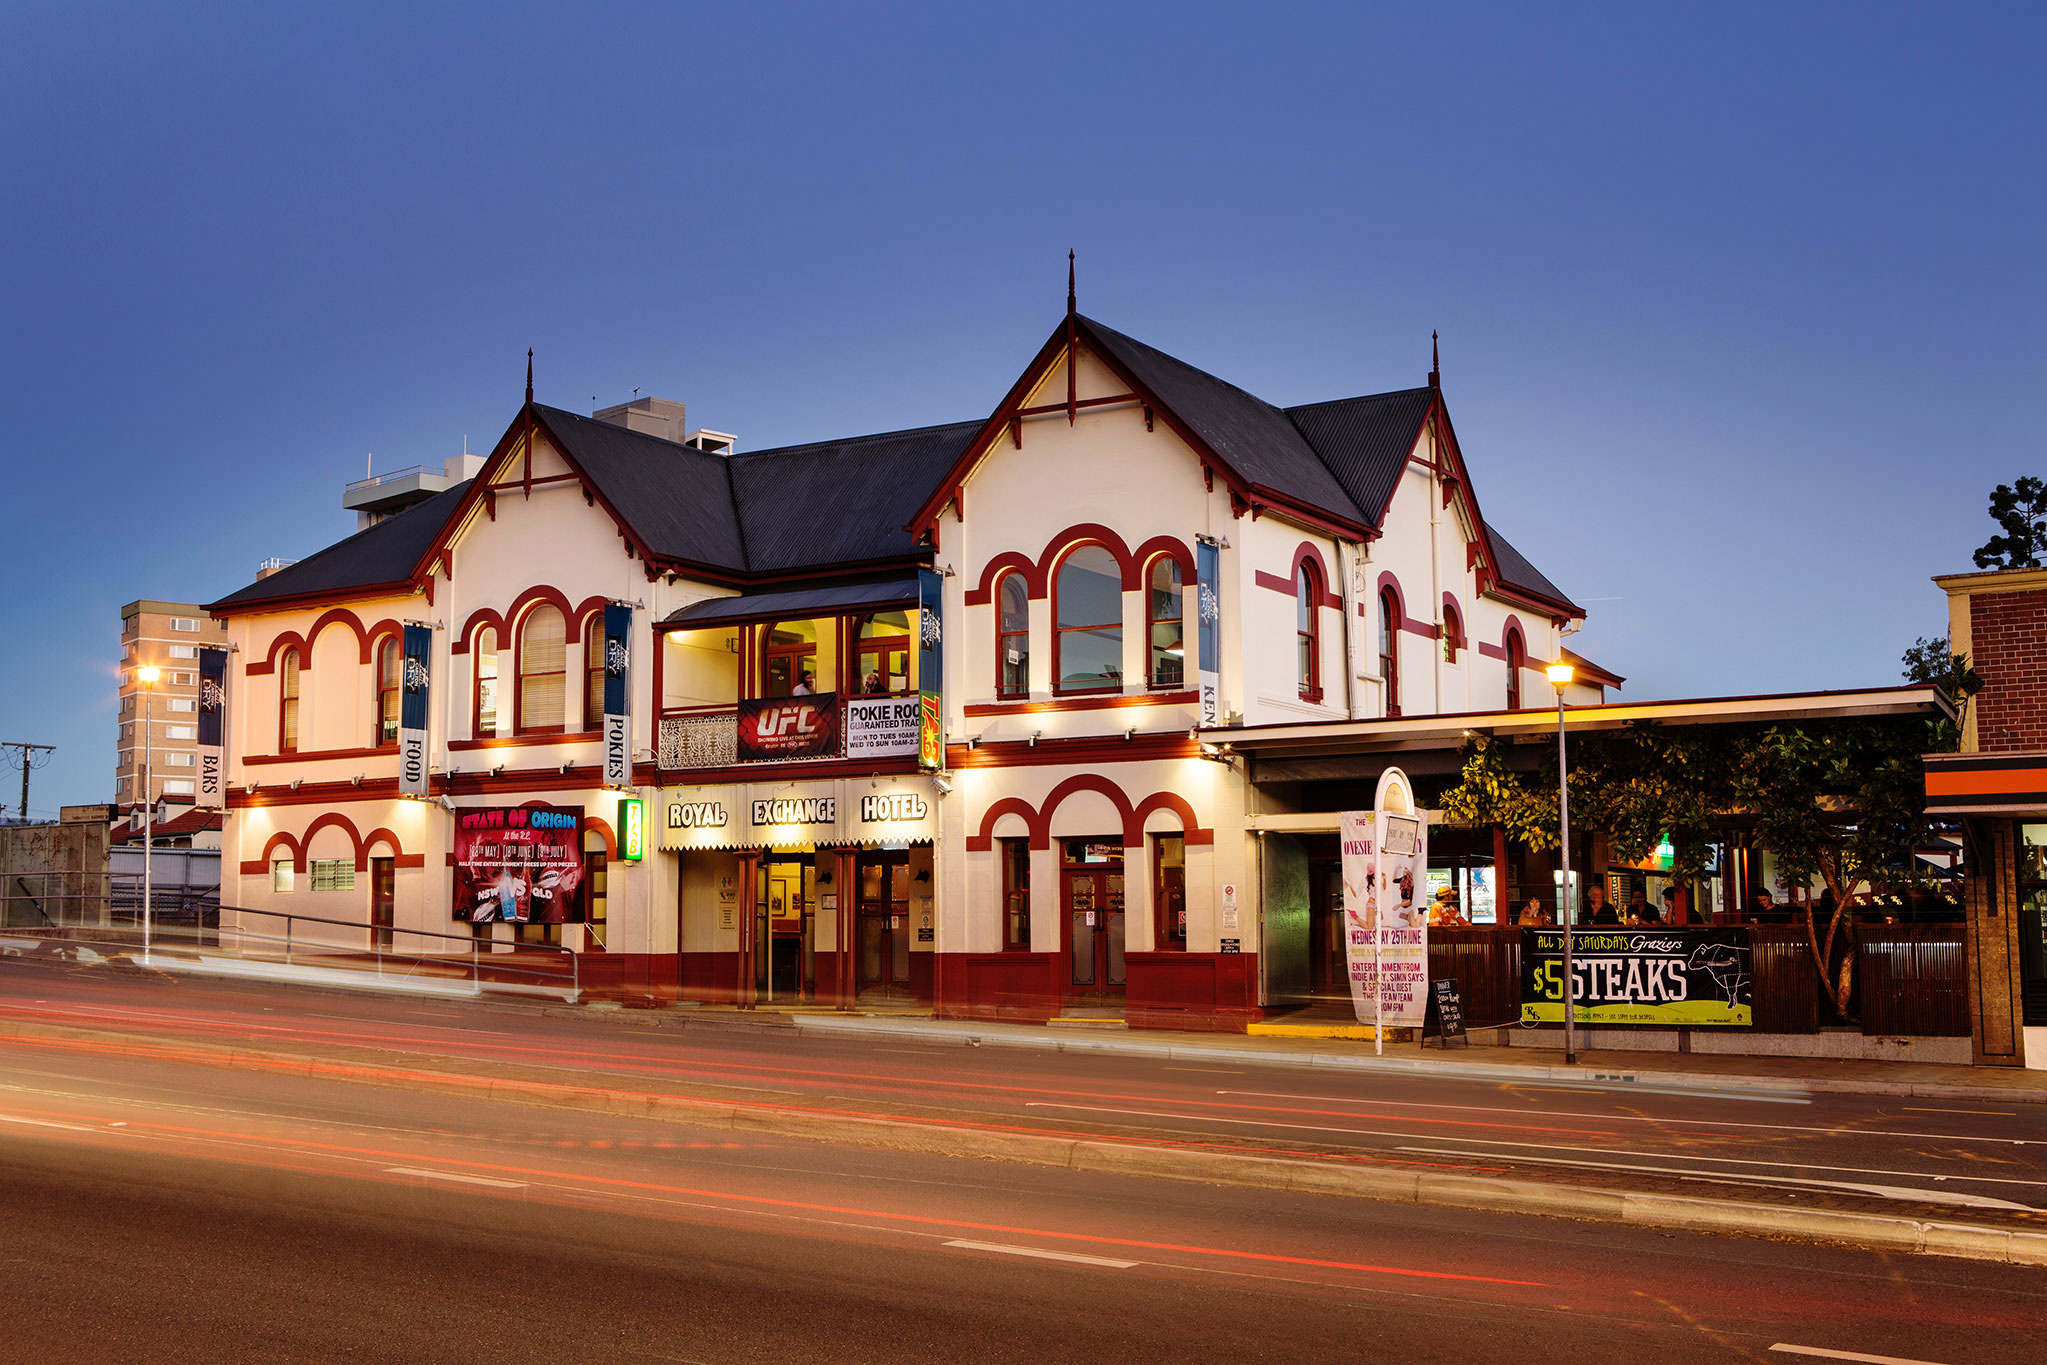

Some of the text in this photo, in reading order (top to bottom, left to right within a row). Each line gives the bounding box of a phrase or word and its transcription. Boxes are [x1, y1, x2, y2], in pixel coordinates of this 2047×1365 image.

[921, 608, 929, 647] DRY
[608, 639, 617, 675] DRY
[407, 657, 416, 691] DRY
[202, 679, 211, 711] DRY
[1203, 684, 1216, 728] KEN
[756, 705, 816, 736] UFC
[850, 705, 891, 721] POKIE
[850, 720, 900, 730] GUARANTEED
[922, 696, 940, 764] TAB
[405, 739, 422, 782] FOOD
[608, 717, 624, 779] POKIES
[202, 755, 219, 794] BARS
[462, 808, 577, 829] STATE OF ORIGIN
[668, 793, 928, 828] ROYAL EXCHANGE HOTEL
[1355, 818, 1366, 826] THE
[1343, 840, 1373, 855] ONESIE
[477, 886, 553, 901] NSW QLD
[1350, 929, 1389, 945] WEDNESAY
[1537, 935, 1684, 953] ALL DY SATURDAYS Graziers
[1351, 972, 1367, 981] INDIE
[1408, 973, 1425, 982] SAYS
[1352, 962, 1403, 972] ENTERTNMENT
[1533, 958, 1687, 1001] $5 STEAKS
[1361, 982, 1367, 991] &
[1368, 983, 1395, 992] SPCIAL
